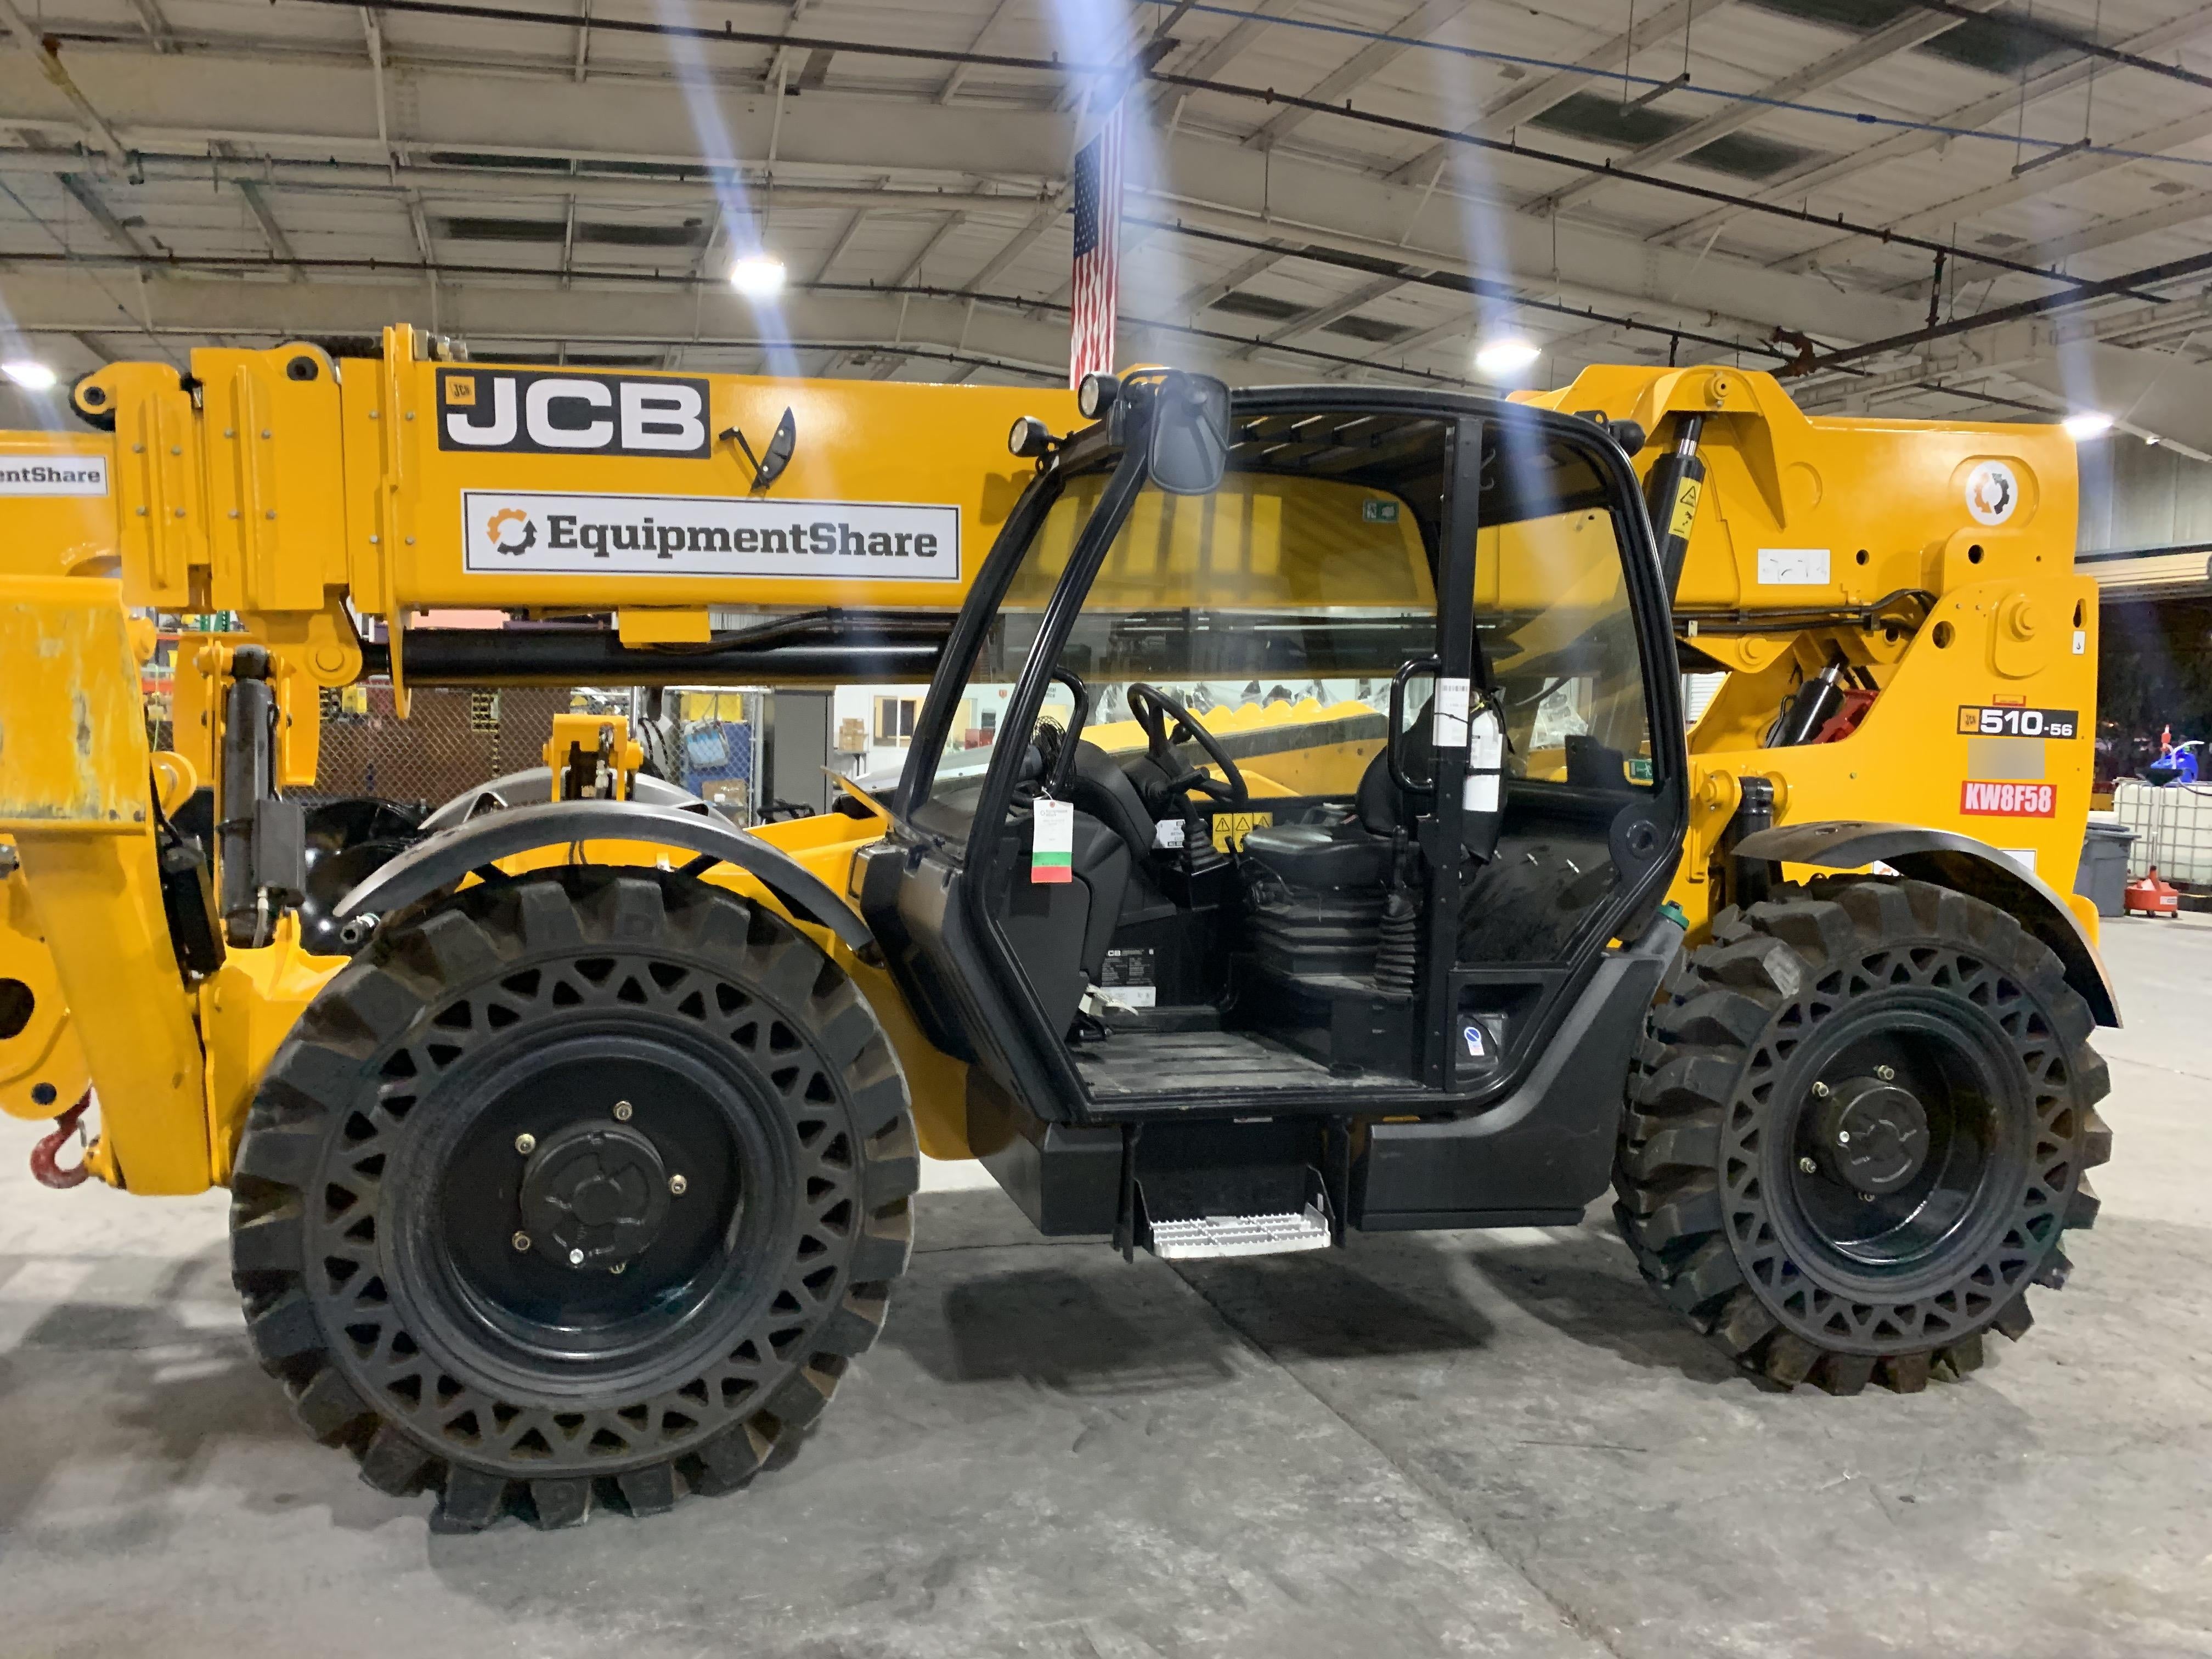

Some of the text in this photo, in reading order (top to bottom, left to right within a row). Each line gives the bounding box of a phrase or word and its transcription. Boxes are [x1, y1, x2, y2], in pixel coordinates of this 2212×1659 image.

[447, 377, 705, 451] JCB
[547, 515, 938, 558] EquipmentShare
[1965, 783, 2052, 812] KW8F58
